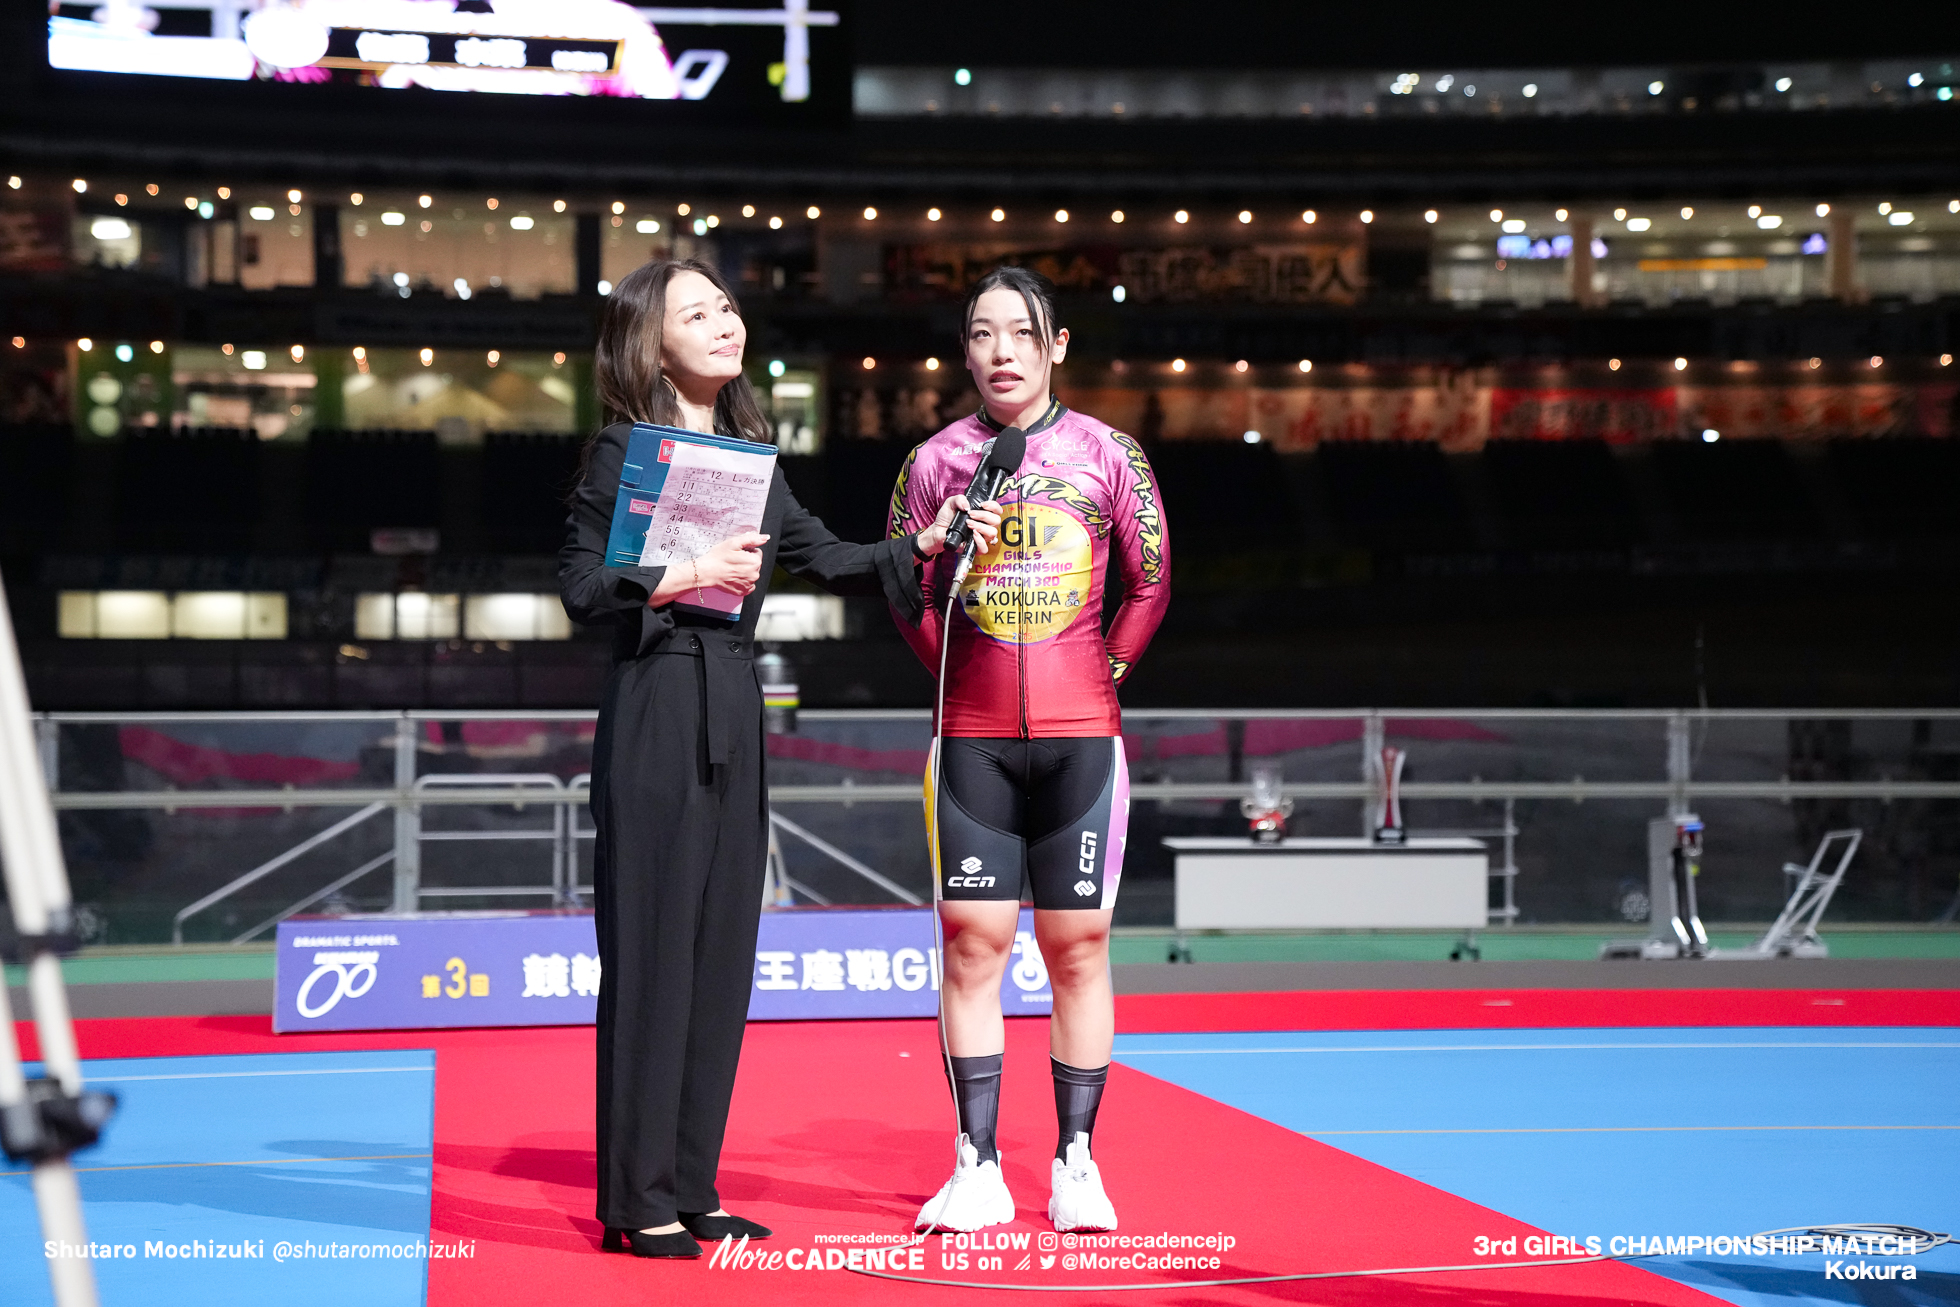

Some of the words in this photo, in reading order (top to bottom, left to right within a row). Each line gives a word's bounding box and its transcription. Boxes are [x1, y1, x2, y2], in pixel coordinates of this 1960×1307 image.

[1041, 440, 1088, 451] CYCLE
[711, 471, 722, 480] 12
[677, 492, 684, 500] 2
[685, 493, 692, 501] 2
[673, 503, 680, 511] 3
[681, 504, 688, 512] 3
[665, 525, 673, 533] 5
[673, 526, 680, 535] 5
[660, 543, 667, 551] 6
[670, 539, 677, 547] 6
[667, 551, 673, 559] 7
[1004, 551, 1042, 560] GIRLS
[975, 562, 1073, 573] CHAMPIONSHIP
[986, 576, 1031, 588] MATCH
[1035, 576, 1060, 586] 3RD
[986, 591, 1061, 606] KOKURA
[994, 611, 1052, 624] KEIRIN
